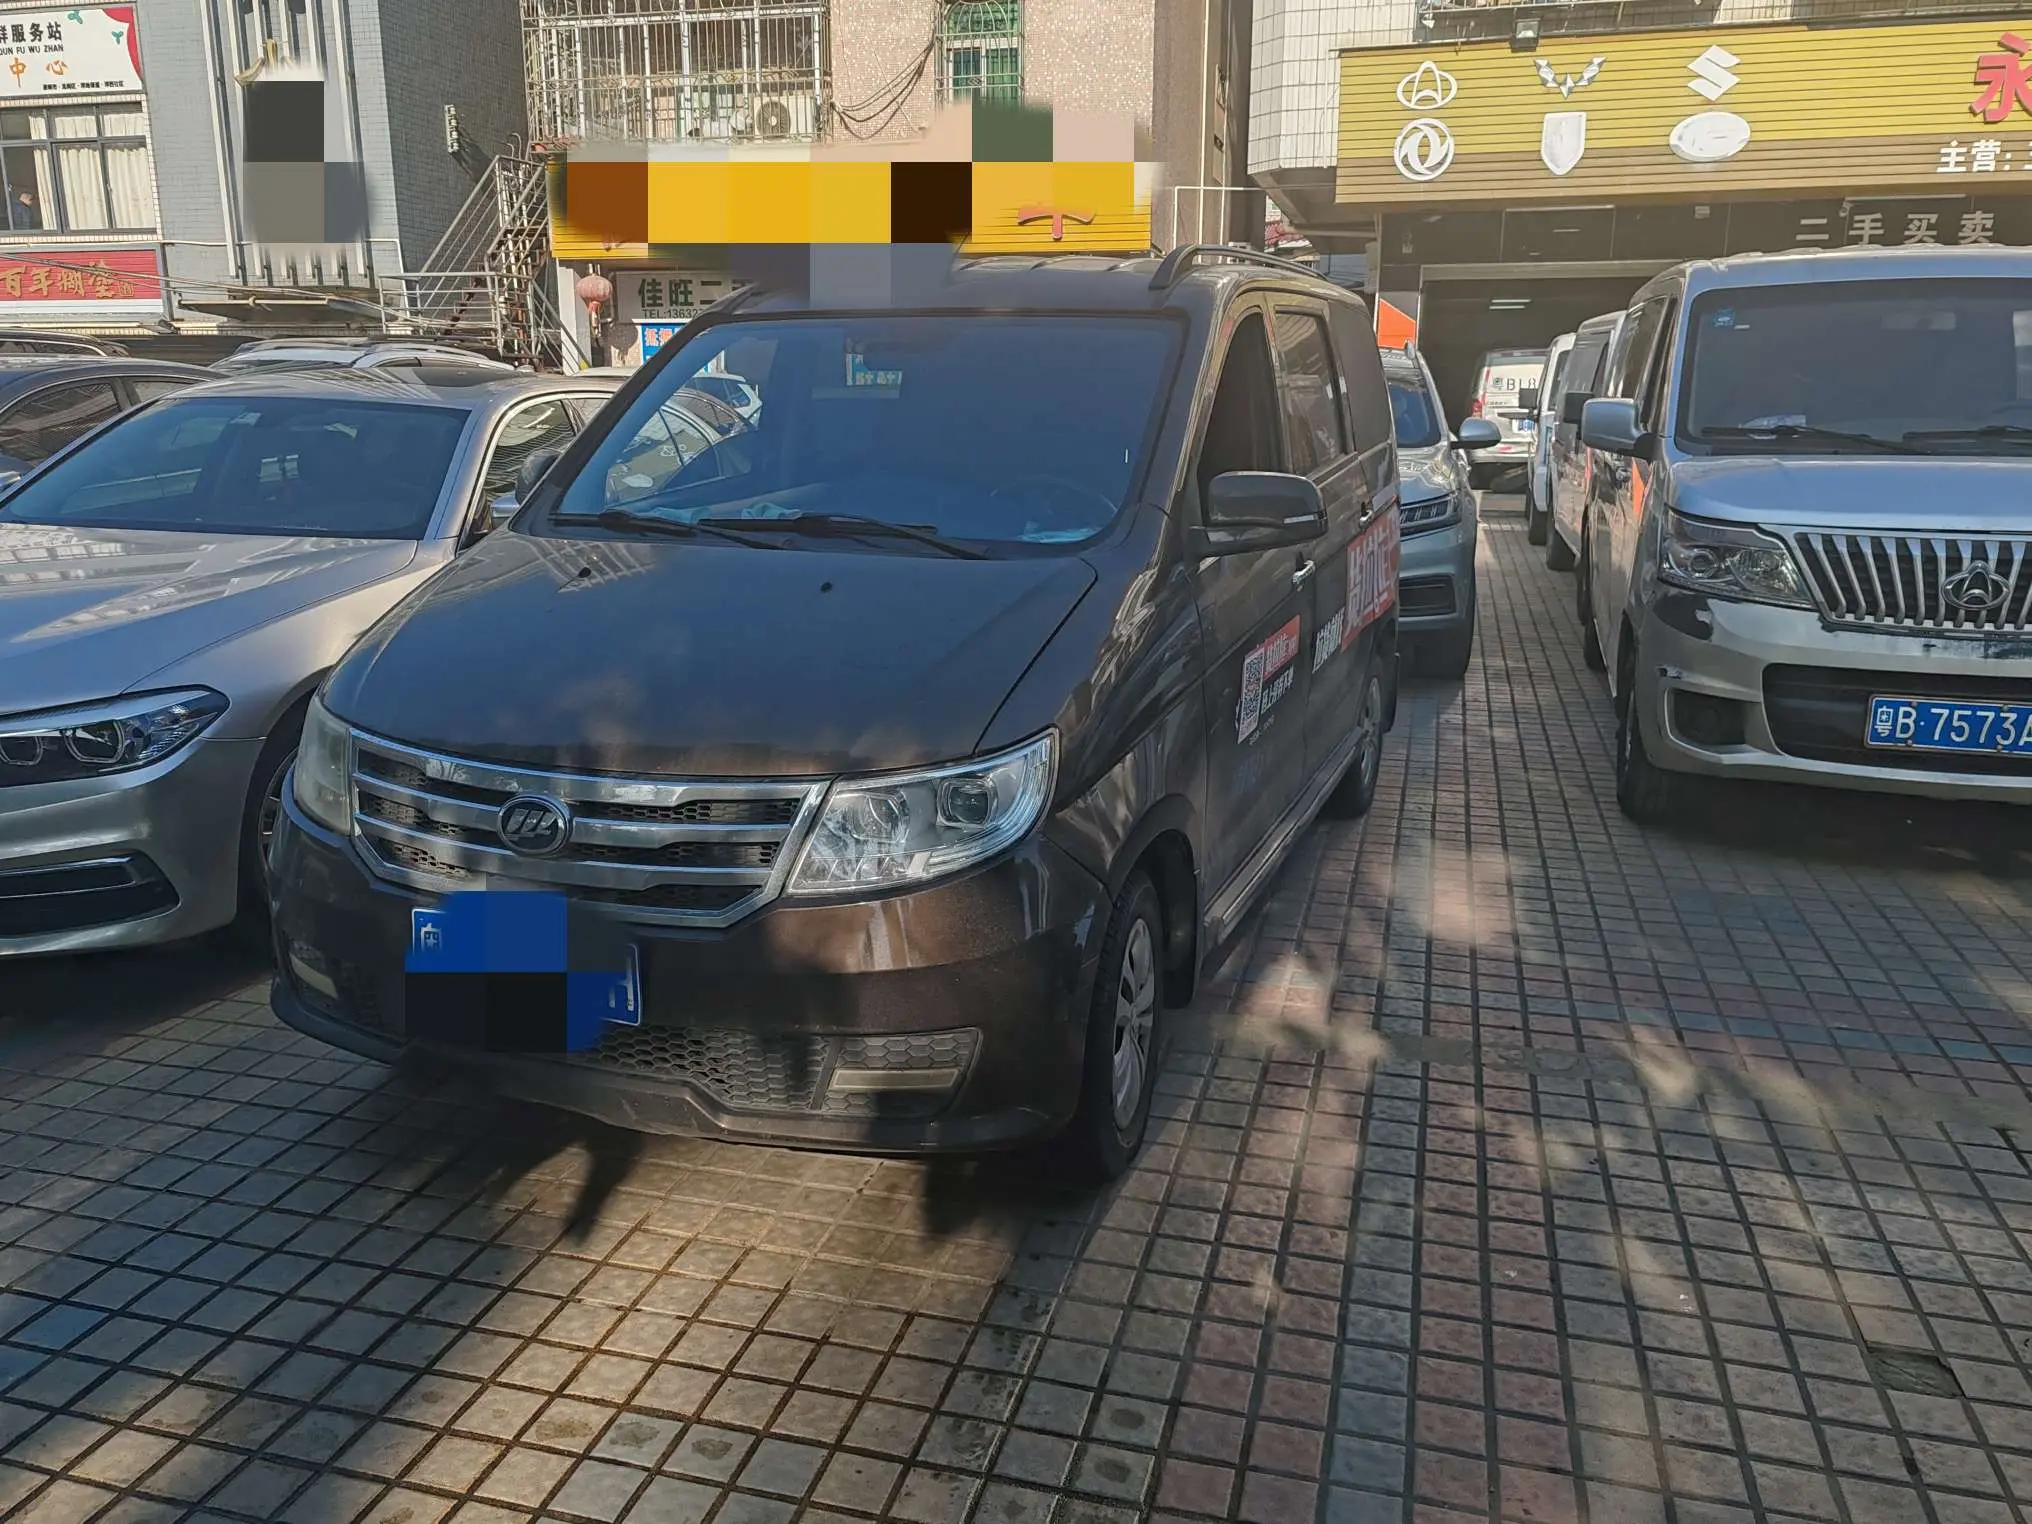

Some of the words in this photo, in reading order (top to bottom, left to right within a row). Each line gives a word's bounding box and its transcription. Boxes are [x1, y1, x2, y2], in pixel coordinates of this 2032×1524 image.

[16, 46, 25, 54] FU
[28, 45, 40, 53] WU
[43, 44, 63, 52] ZHAN
[1796, 210, 1995, 245] 二手买卖
[642, 309, 707, 319] TEL:13632
